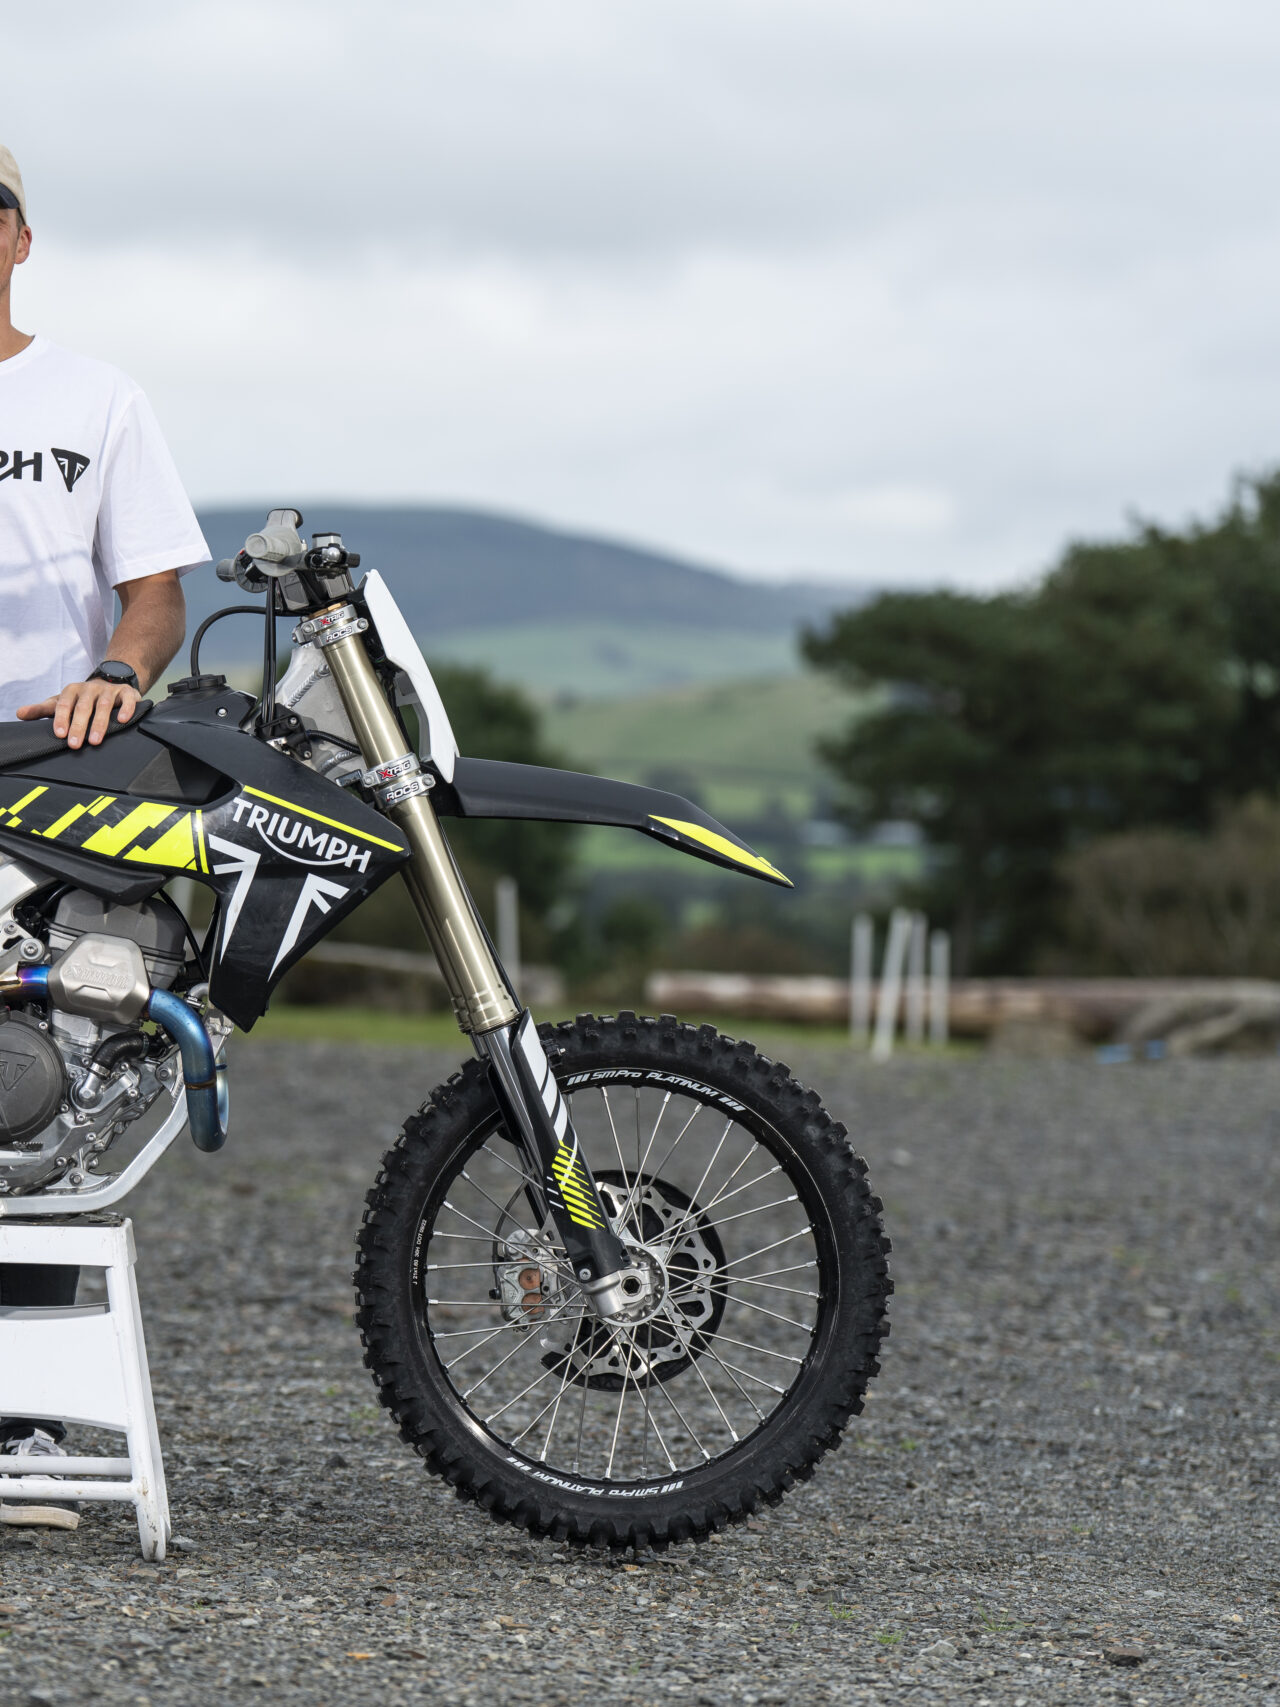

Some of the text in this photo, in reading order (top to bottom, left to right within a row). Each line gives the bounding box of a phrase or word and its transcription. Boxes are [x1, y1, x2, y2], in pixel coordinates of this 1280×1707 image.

[326, 626, 353, 642] ROCS
[376, 760, 411, 780] XTRIG
[386, 781, 419, 802] ROCS
[232, 796, 372, 874] TRIUMPH
[645, 1071, 720, 1098] PLATINUM
